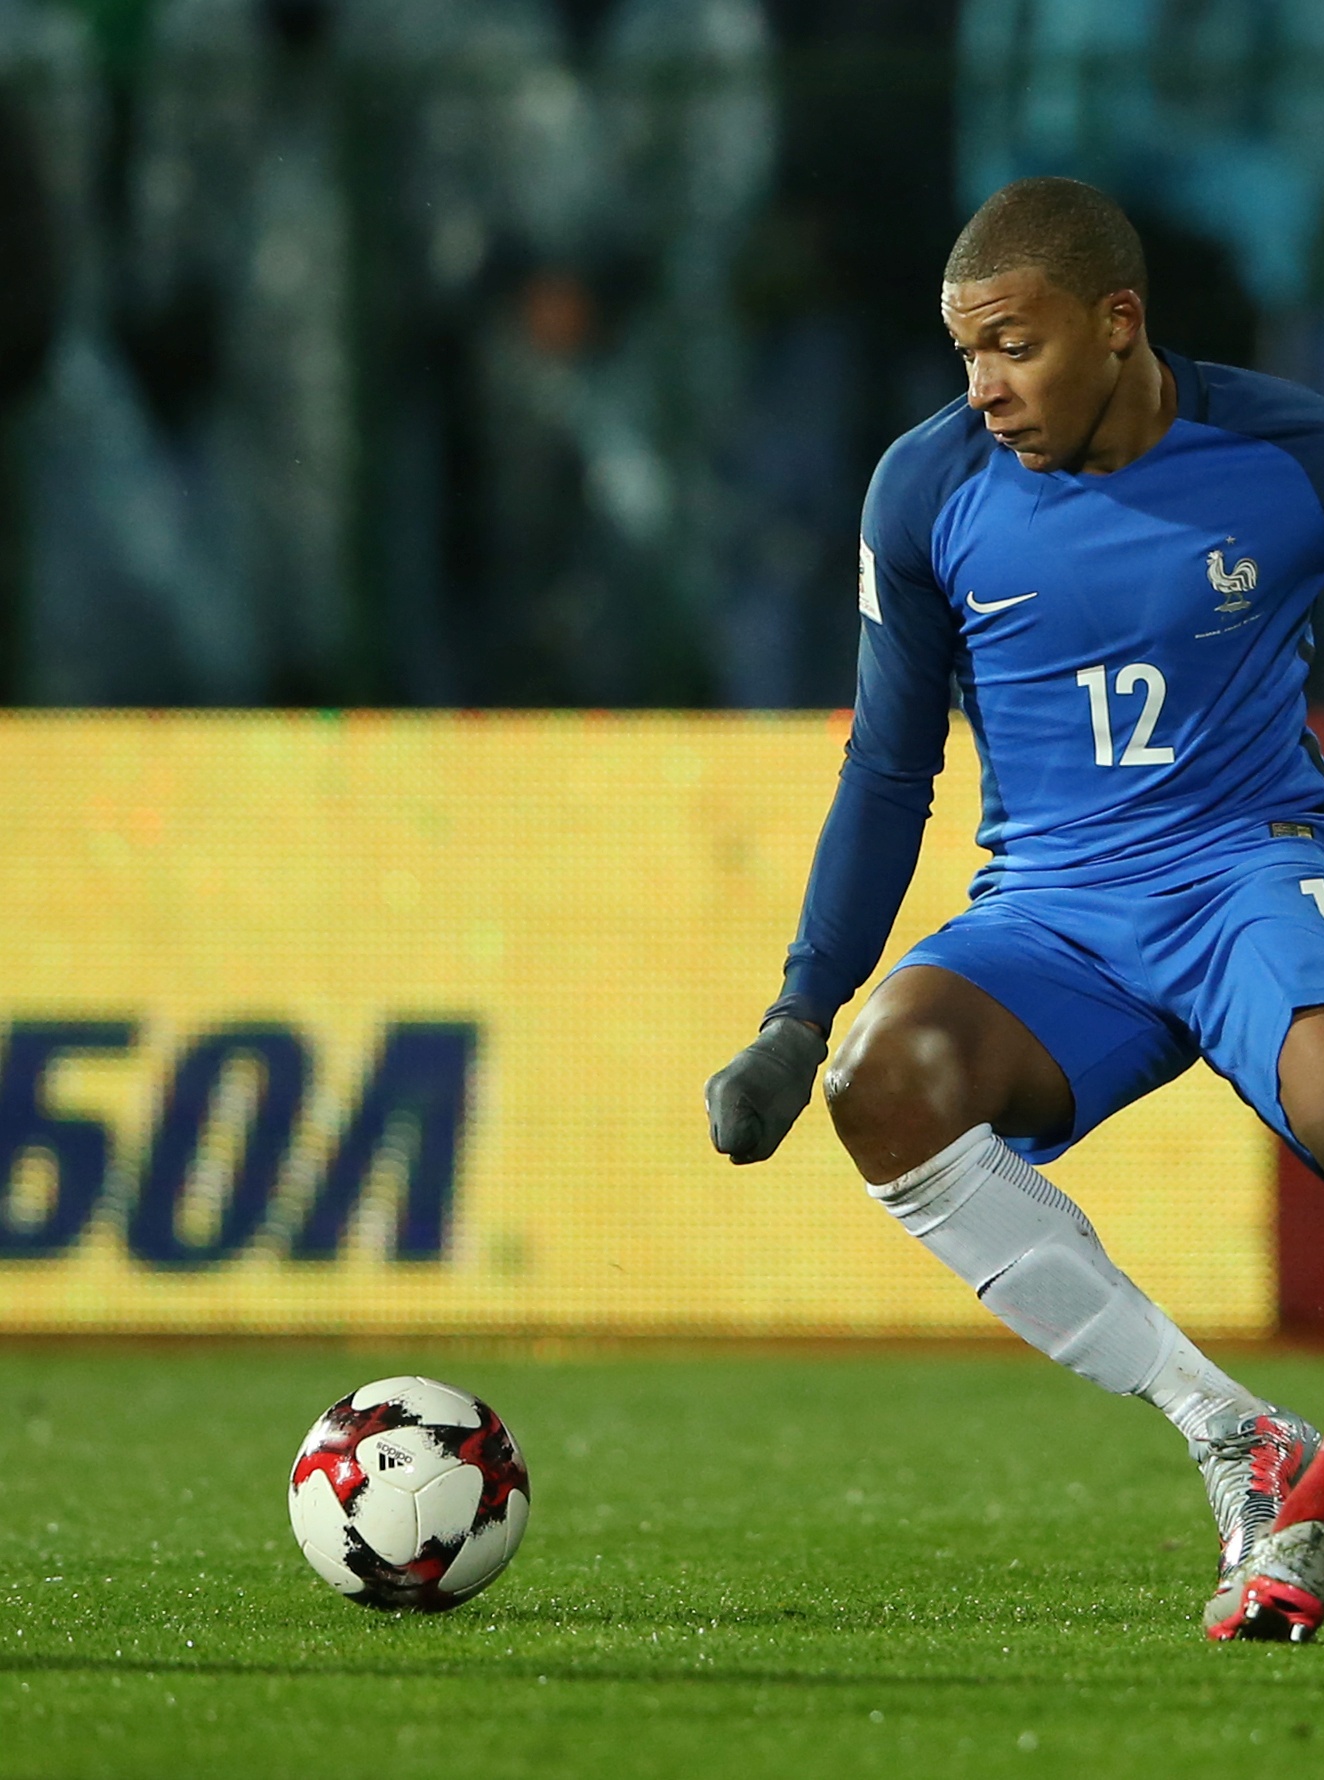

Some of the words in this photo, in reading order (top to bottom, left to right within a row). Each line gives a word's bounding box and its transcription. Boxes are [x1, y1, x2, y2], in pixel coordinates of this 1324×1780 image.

[1077, 663, 1175, 767] 12
[0, 1020, 482, 1262] БОЛ
[376, 1441, 413, 1464] adidas
